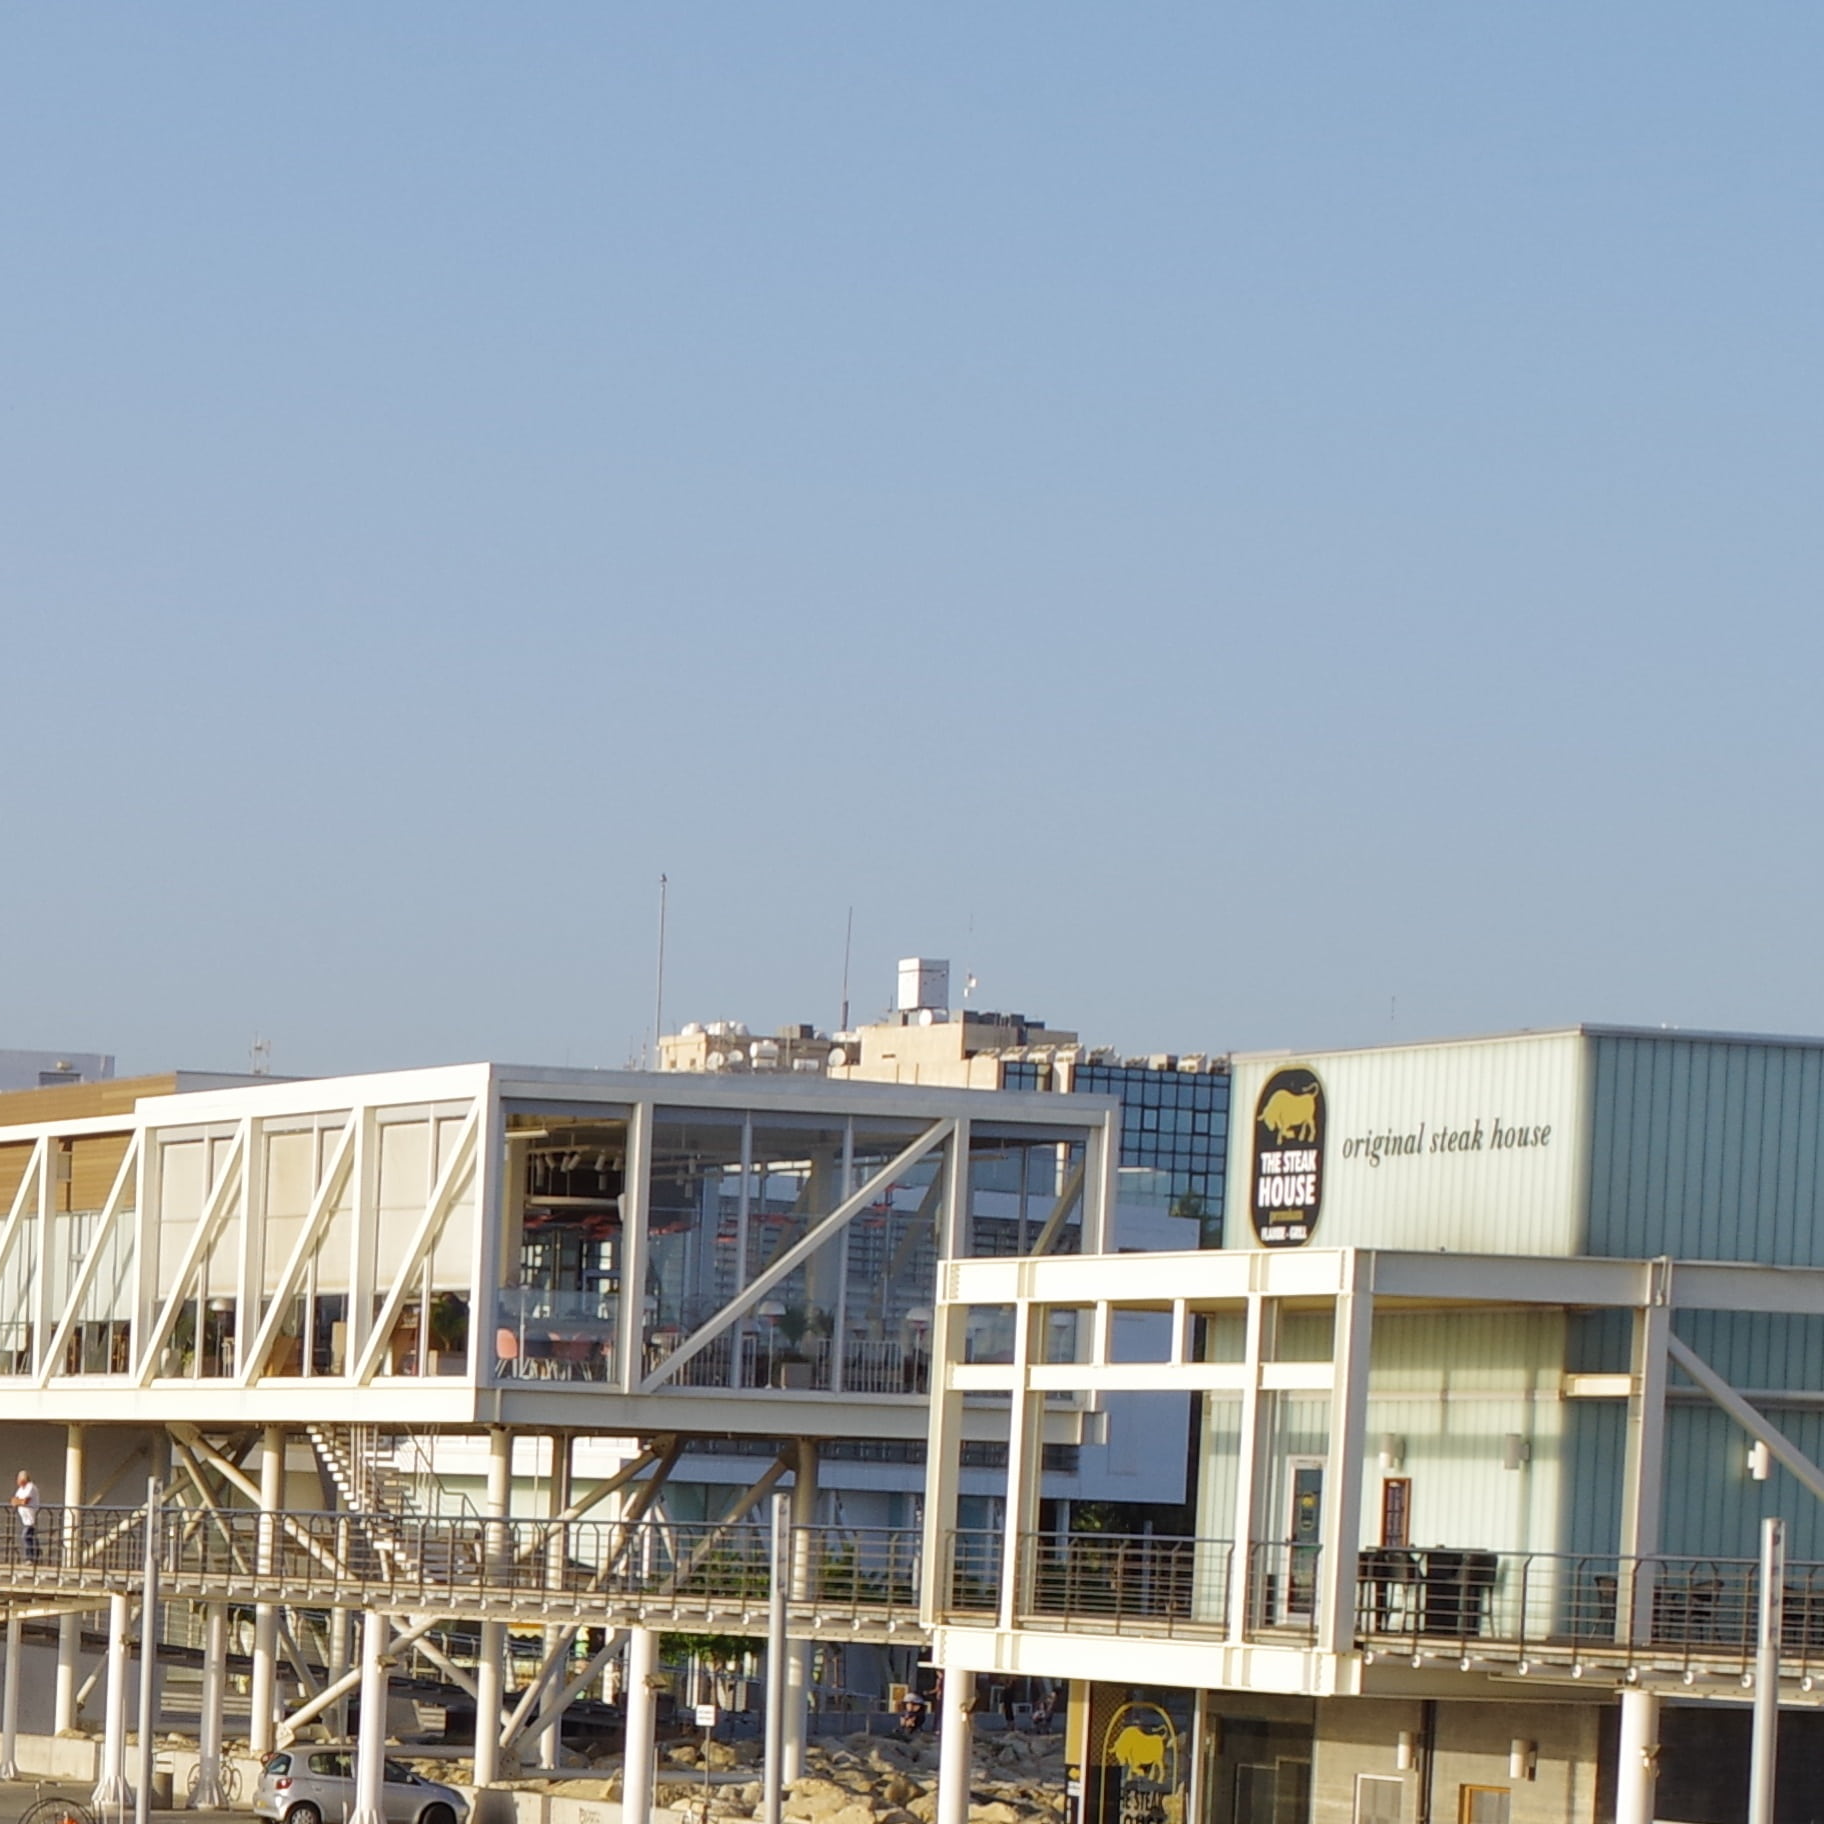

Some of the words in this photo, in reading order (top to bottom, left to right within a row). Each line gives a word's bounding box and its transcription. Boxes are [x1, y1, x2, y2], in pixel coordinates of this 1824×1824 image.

[1342, 1121, 1426, 1169] original
[1429, 1117, 1484, 1155] steak
[1489, 1117, 1552, 1150] house
[1260, 1151, 1282, 1174] THE
[1283, 1149, 1318, 1173] STEAK
[1258, 1174, 1317, 1208] HOUSE
